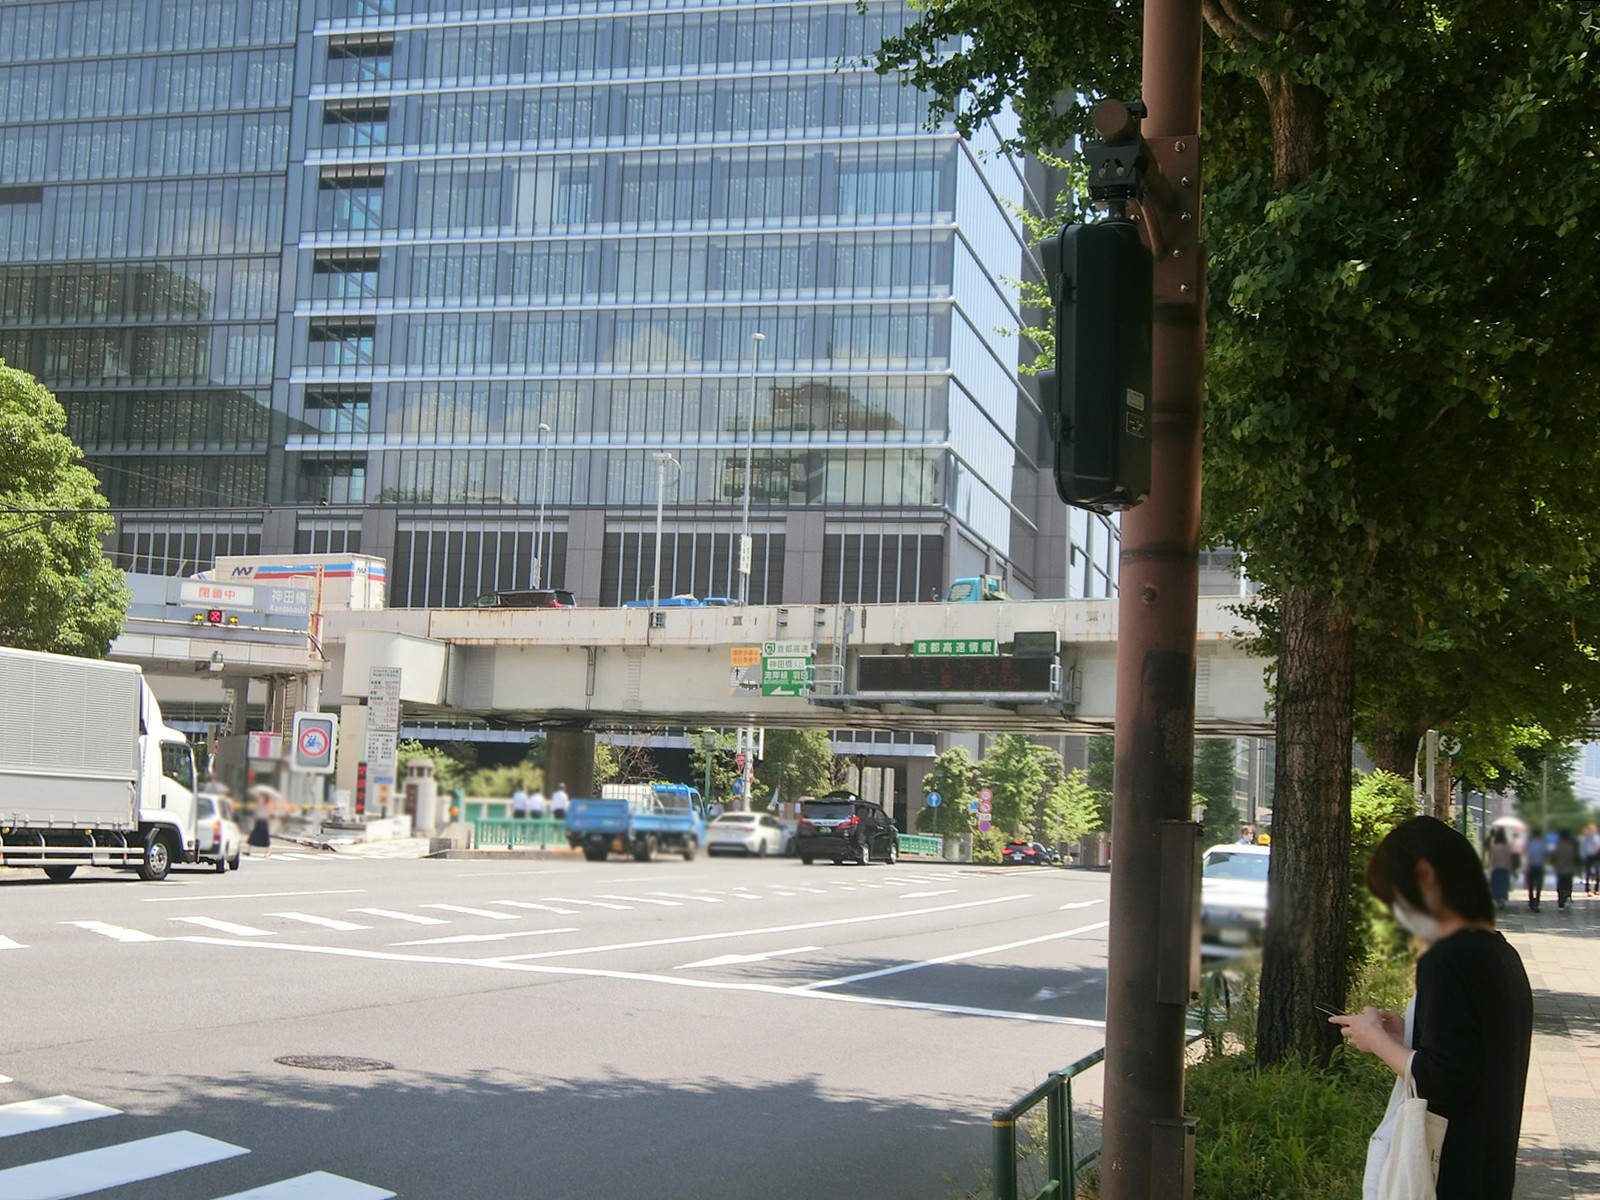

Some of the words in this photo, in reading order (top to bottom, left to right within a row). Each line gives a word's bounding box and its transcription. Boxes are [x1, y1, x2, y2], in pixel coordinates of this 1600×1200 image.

[271, 589, 307, 605] 神田橋
[777, 644, 809, 653] 首都高速
[917, 641, 992, 654] 首都高速情報
